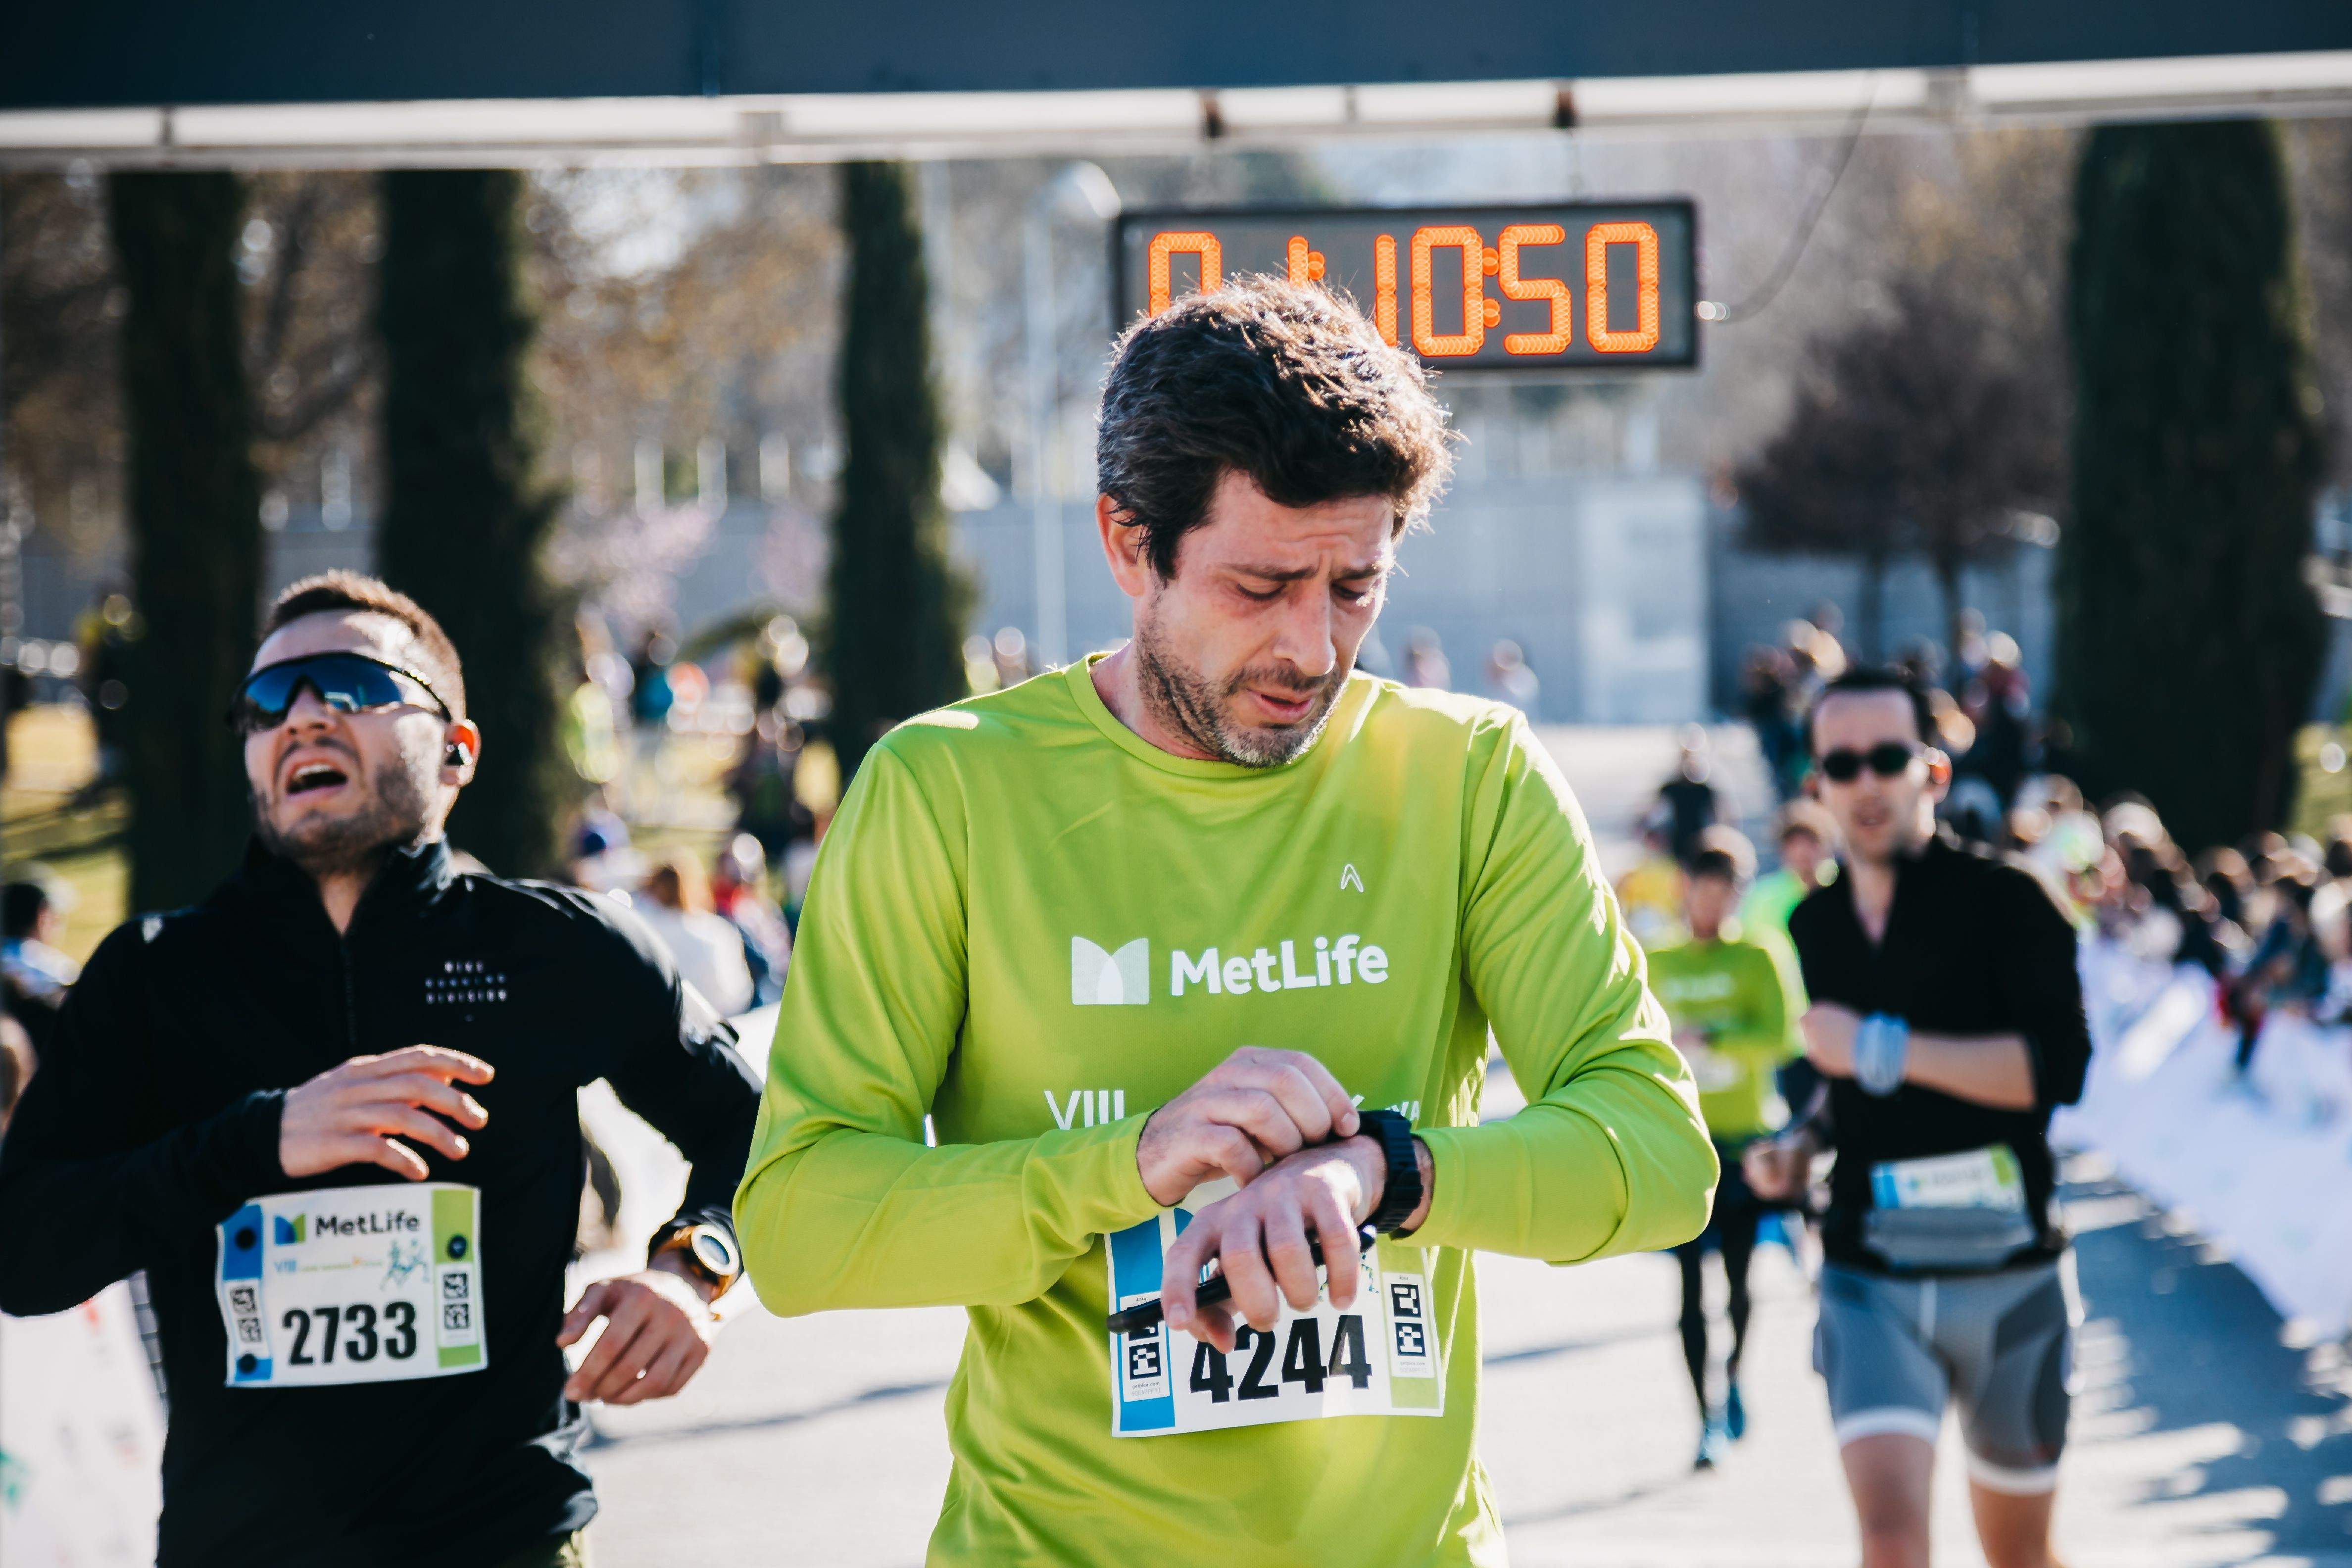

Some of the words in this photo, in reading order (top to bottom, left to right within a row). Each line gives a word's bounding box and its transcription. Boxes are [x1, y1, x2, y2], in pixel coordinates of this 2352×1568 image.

[1171, 933, 1389, 996] MetLife
[1044, 1089, 1125, 1130] VIII
[315, 1210, 420, 1237] MetLife
[283, 1301, 417, 1366] 2733
[1189, 1314, 1372, 1404] 4244
